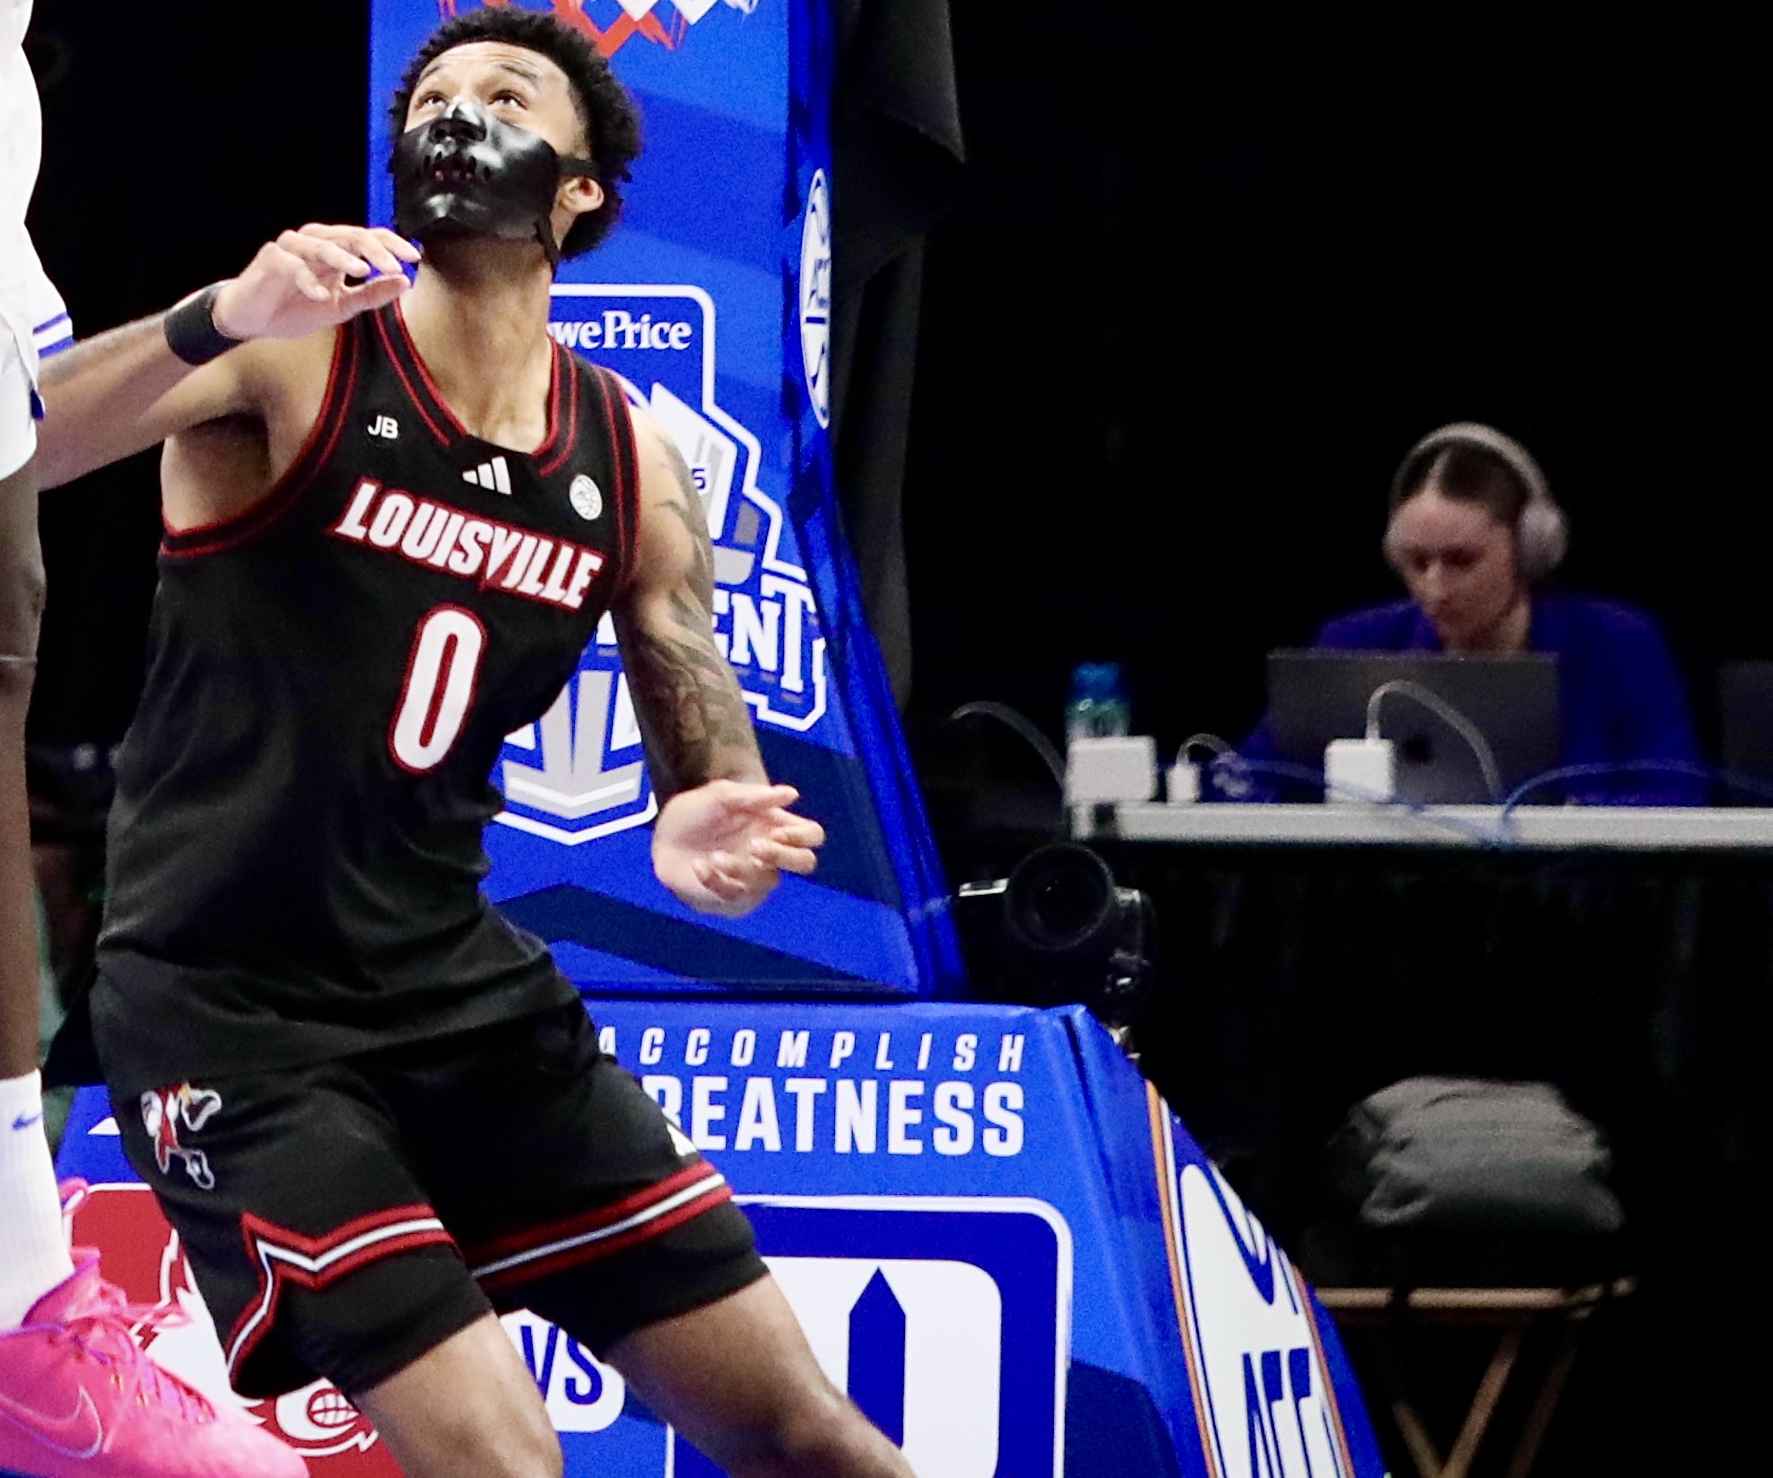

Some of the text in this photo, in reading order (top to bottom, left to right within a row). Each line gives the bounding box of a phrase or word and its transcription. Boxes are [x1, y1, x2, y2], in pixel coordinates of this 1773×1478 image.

[367, 415, 399, 439] JB
[332, 480, 606, 611] LOUISVILLE
[388, 601, 488, 775] 0
[520, 1323, 603, 1405] VS
